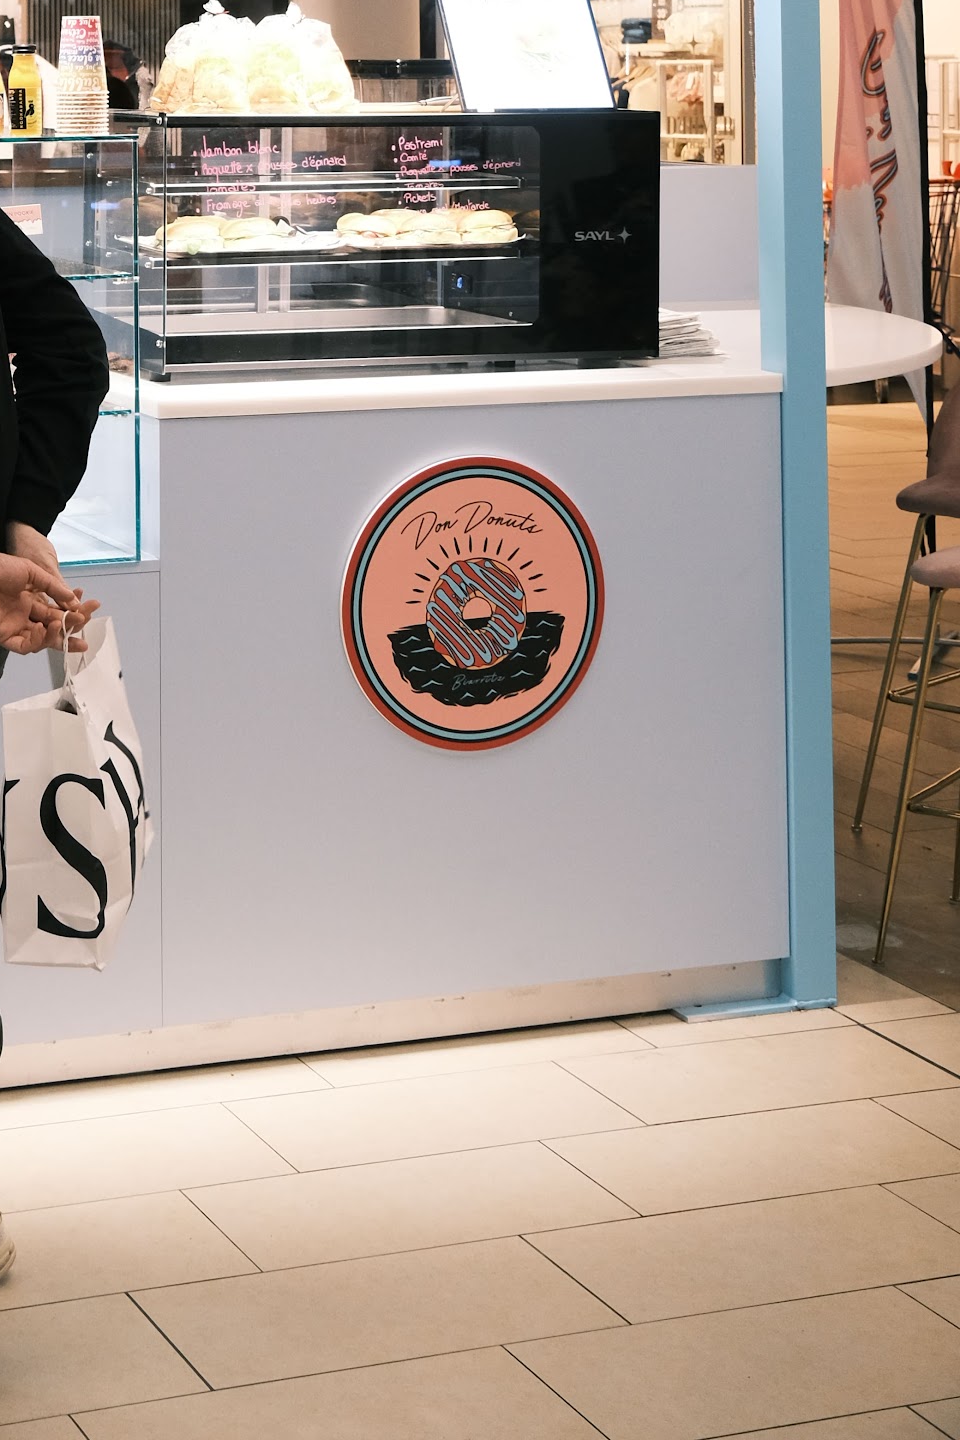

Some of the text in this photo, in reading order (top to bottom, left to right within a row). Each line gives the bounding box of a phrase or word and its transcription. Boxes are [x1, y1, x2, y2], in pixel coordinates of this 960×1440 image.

[200, 135, 242, 158] Jambon
[398, 132, 444, 151] Pastrami
[301, 155, 347, 170] d'épinard
[399, 150, 428, 163] Comté
[206, 198, 251, 218] Fromage
[574, 231, 615, 242] SAYL
[400, 500, 544, 550] Don Donuts
[451, 672, 506, 691] Biarritz
